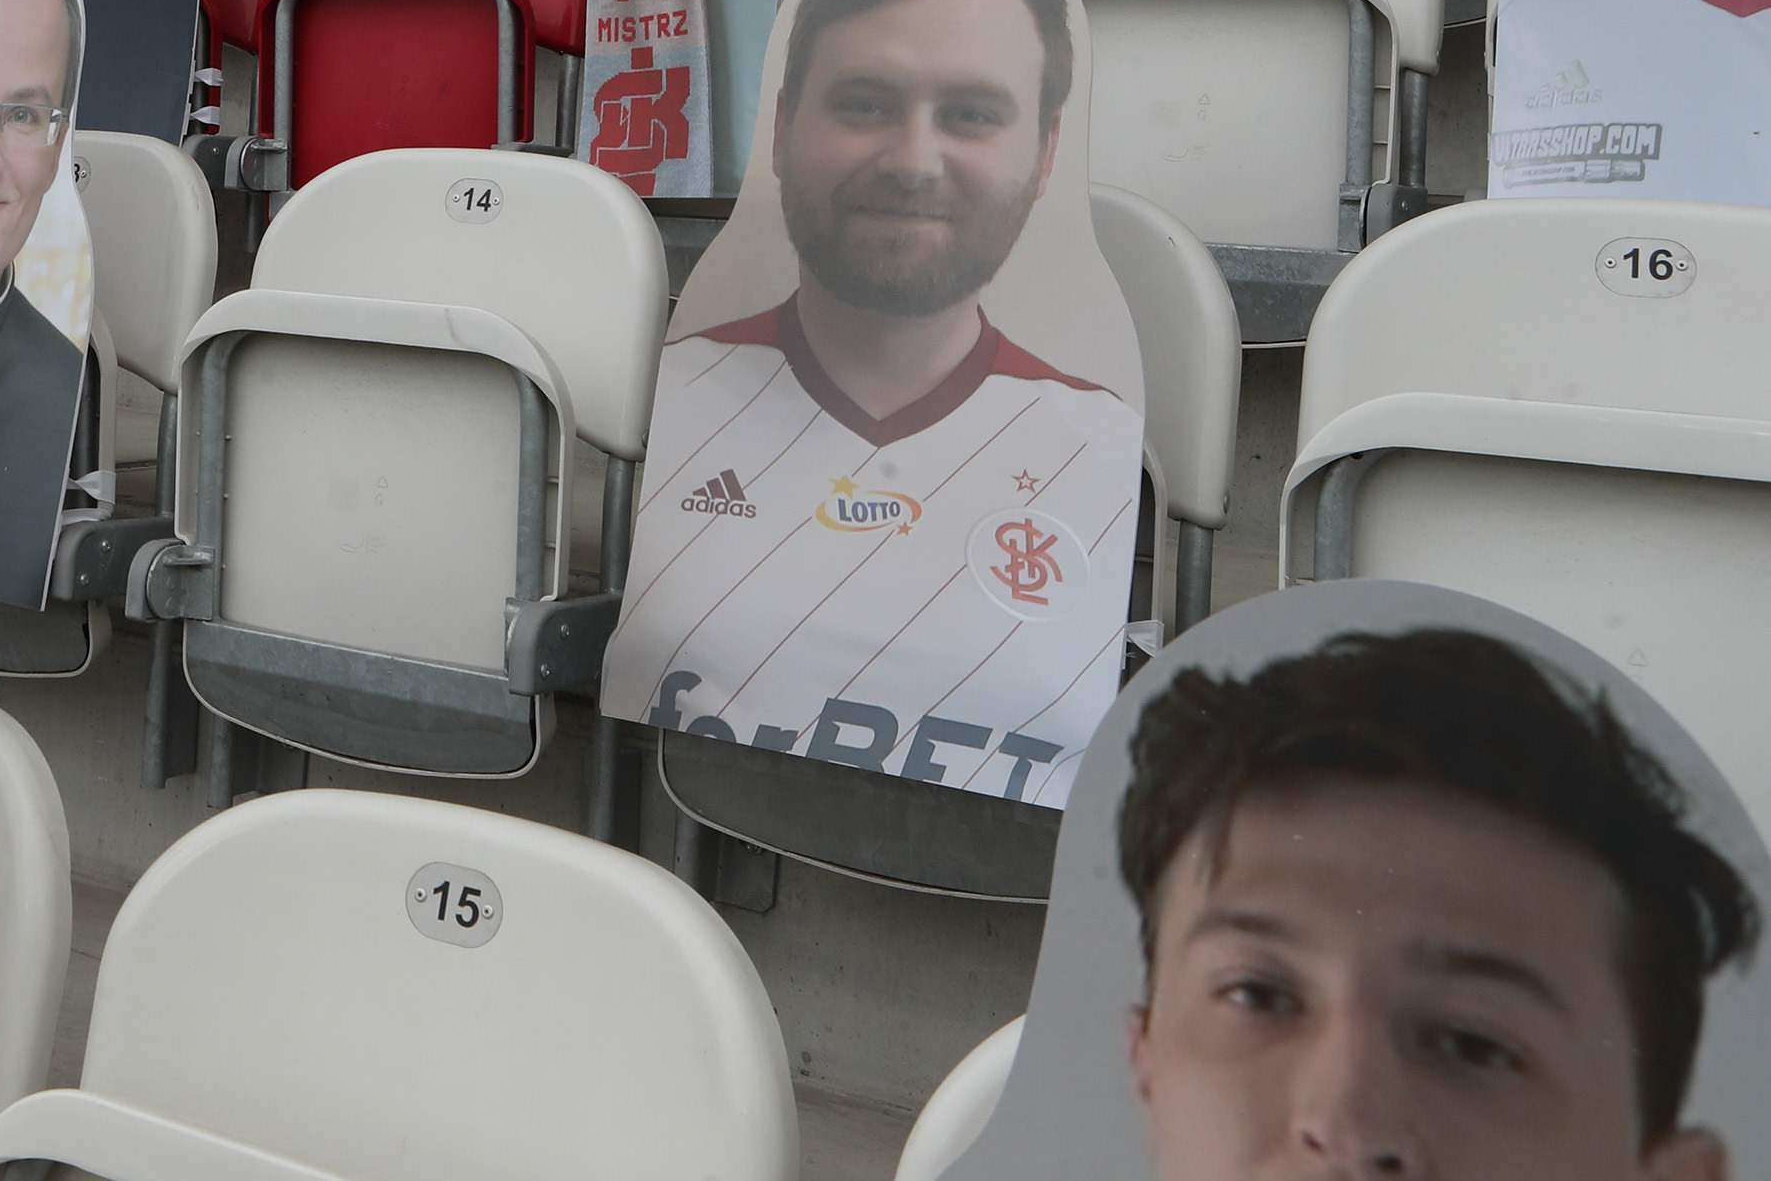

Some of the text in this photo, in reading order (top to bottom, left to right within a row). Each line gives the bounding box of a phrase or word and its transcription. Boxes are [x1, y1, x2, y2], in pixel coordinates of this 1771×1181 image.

[597, 10, 688, 43] MISTRZ
[462, 188, 492, 213] 14
[1621, 249, 1674, 280] 16
[681, 494, 757, 519] adidas
[837, 498, 901, 523] LOTTO
[430, 881, 482, 929] 15
